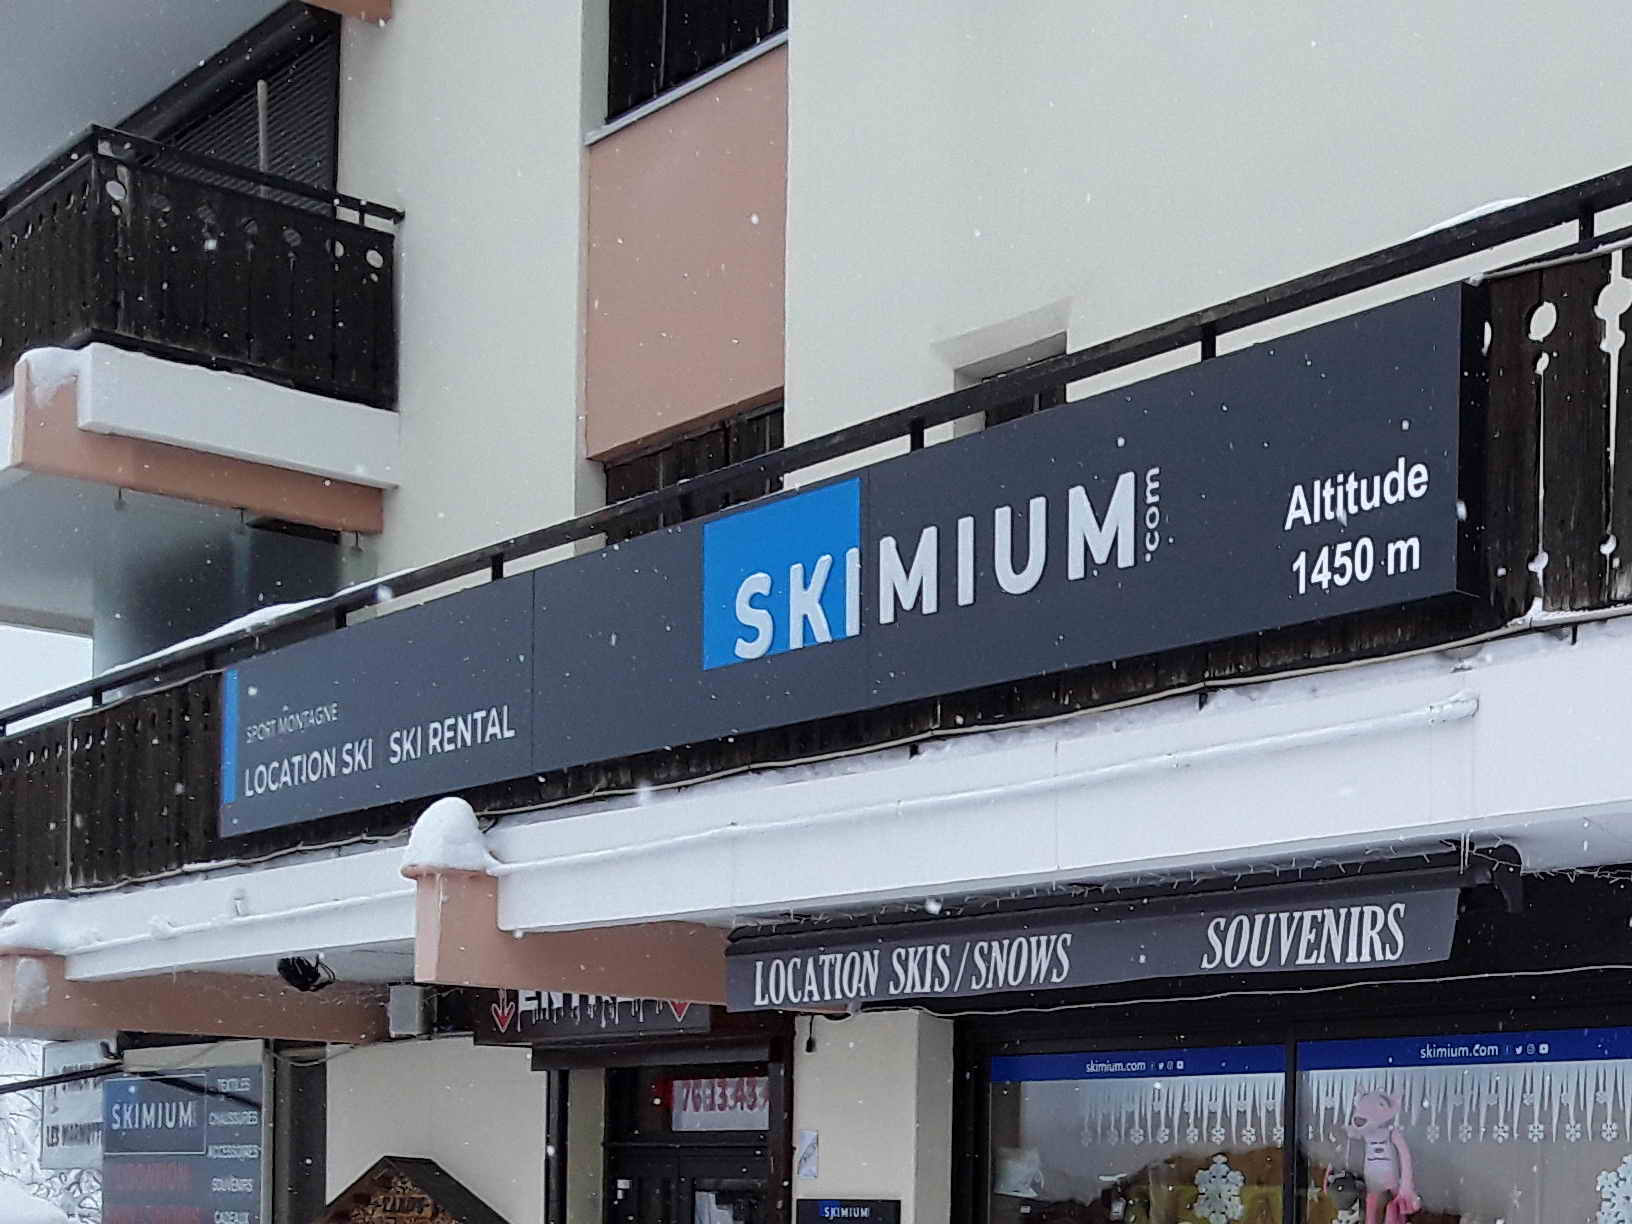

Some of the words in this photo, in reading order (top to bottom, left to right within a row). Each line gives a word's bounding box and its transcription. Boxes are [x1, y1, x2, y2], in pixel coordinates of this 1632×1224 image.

[1284, 457, 1429, 530] Altitude
[734, 471, 1136, 660] SKIMIUM
[1144, 467, 1160, 562] .com
[1292, 537, 1374, 595] 1450
[1387, 536, 1420, 576] m
[244, 747, 336, 797] LOCATION
[341, 738, 373, 775] SKI
[389, 725, 421, 764] SKI
[428, 704, 516, 755] RENTAL
[246, 722, 276, 743] SPORT
[277, 703, 338, 735] MONTAGNE
[1201, 902, 1406, 969] SOUVENIRS
[754, 950, 880, 1006] LOCATION
[1086, 1059, 1146, 1073] skimium.com
[1420, 1043, 1499, 1059] skimium.com
[111, 1101, 193, 1130] SKIMIUM
[824, 1206, 871, 1218] SKIMIUM
